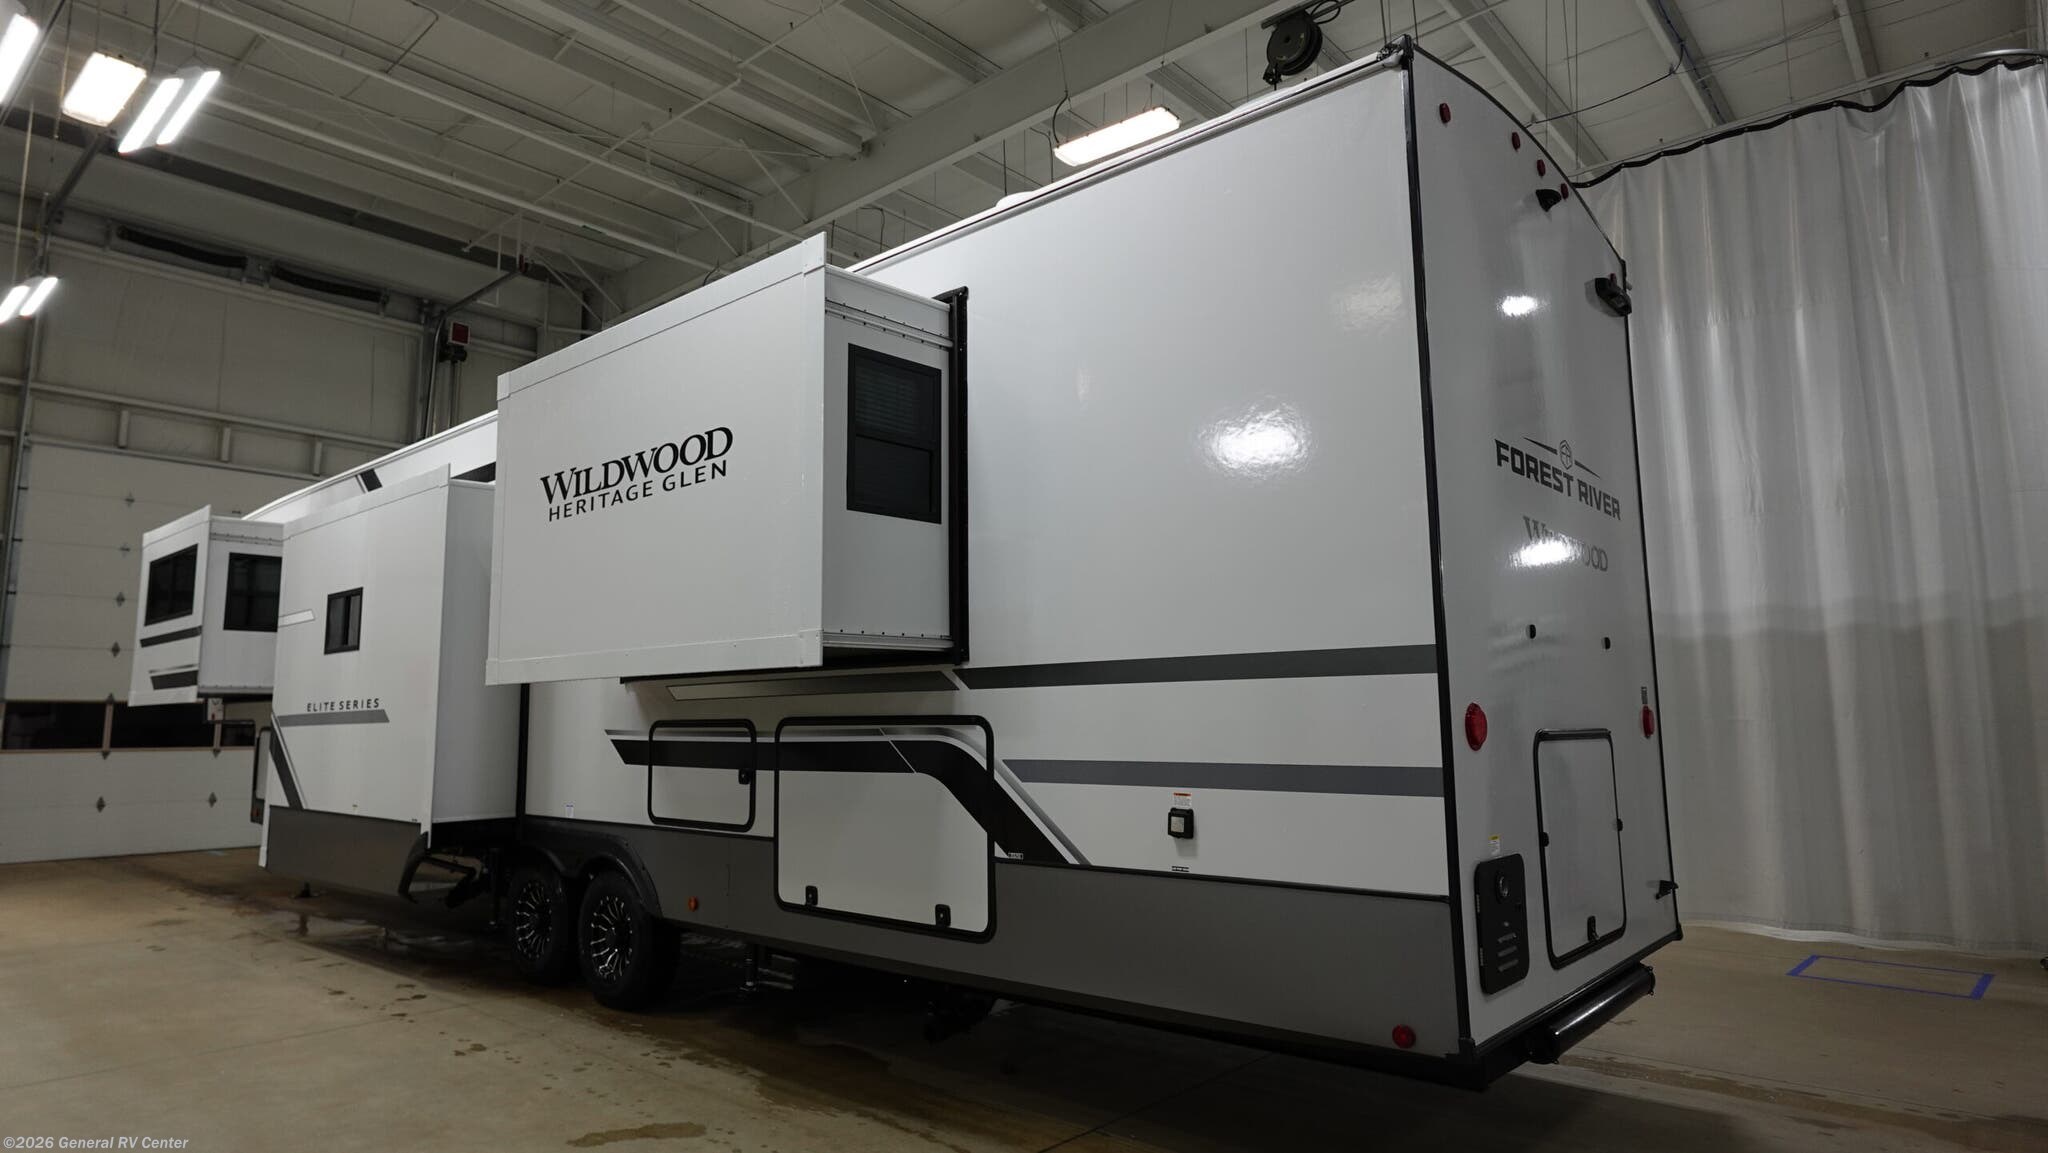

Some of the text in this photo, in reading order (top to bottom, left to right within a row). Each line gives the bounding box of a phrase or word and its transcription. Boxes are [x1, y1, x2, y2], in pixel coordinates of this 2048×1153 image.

[540, 426, 734, 504] WILDWOOD
[548, 460, 727, 522] HERITAGE GLEN
[1494, 438, 1622, 520] FOREST RIVER
[306, 698, 380, 712] ELITE SERIES
